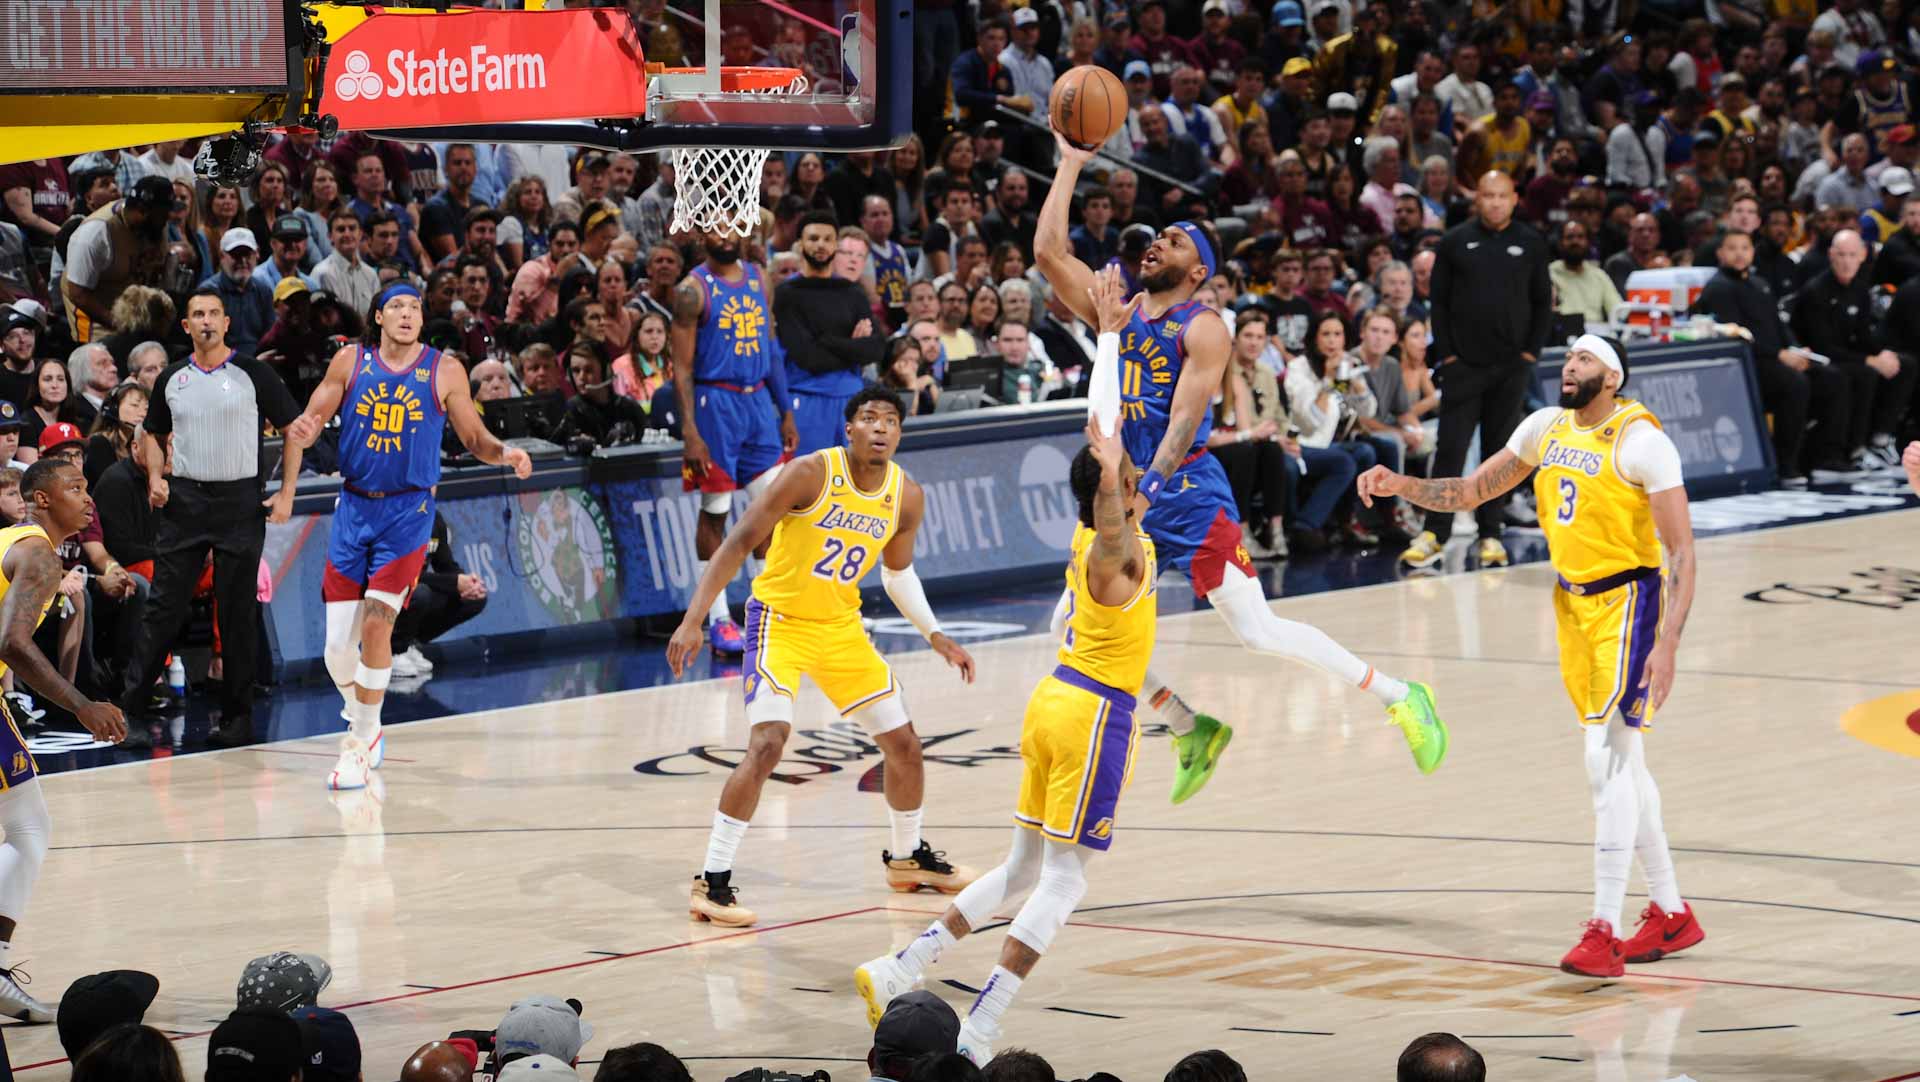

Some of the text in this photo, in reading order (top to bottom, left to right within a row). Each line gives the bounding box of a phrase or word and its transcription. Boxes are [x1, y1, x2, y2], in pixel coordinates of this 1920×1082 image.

[8, 0, 268, 69] GET THE NBA APP
[733, 312, 758, 338] 32
[1122, 359, 1142, 397] 11
[1139, 336, 1172, 383] HIGH
[355, 382, 424, 421] MILE HIGH
[372, 402, 405, 433] 50
[366, 433, 402, 454] CITY
[1541, 439, 1603, 476] LAKERS
[964, 475, 1005, 550] ET
[1557, 477, 1577, 522] 3
[814, 503, 889, 539] LAKERS
[812, 536, 867, 583] 28
